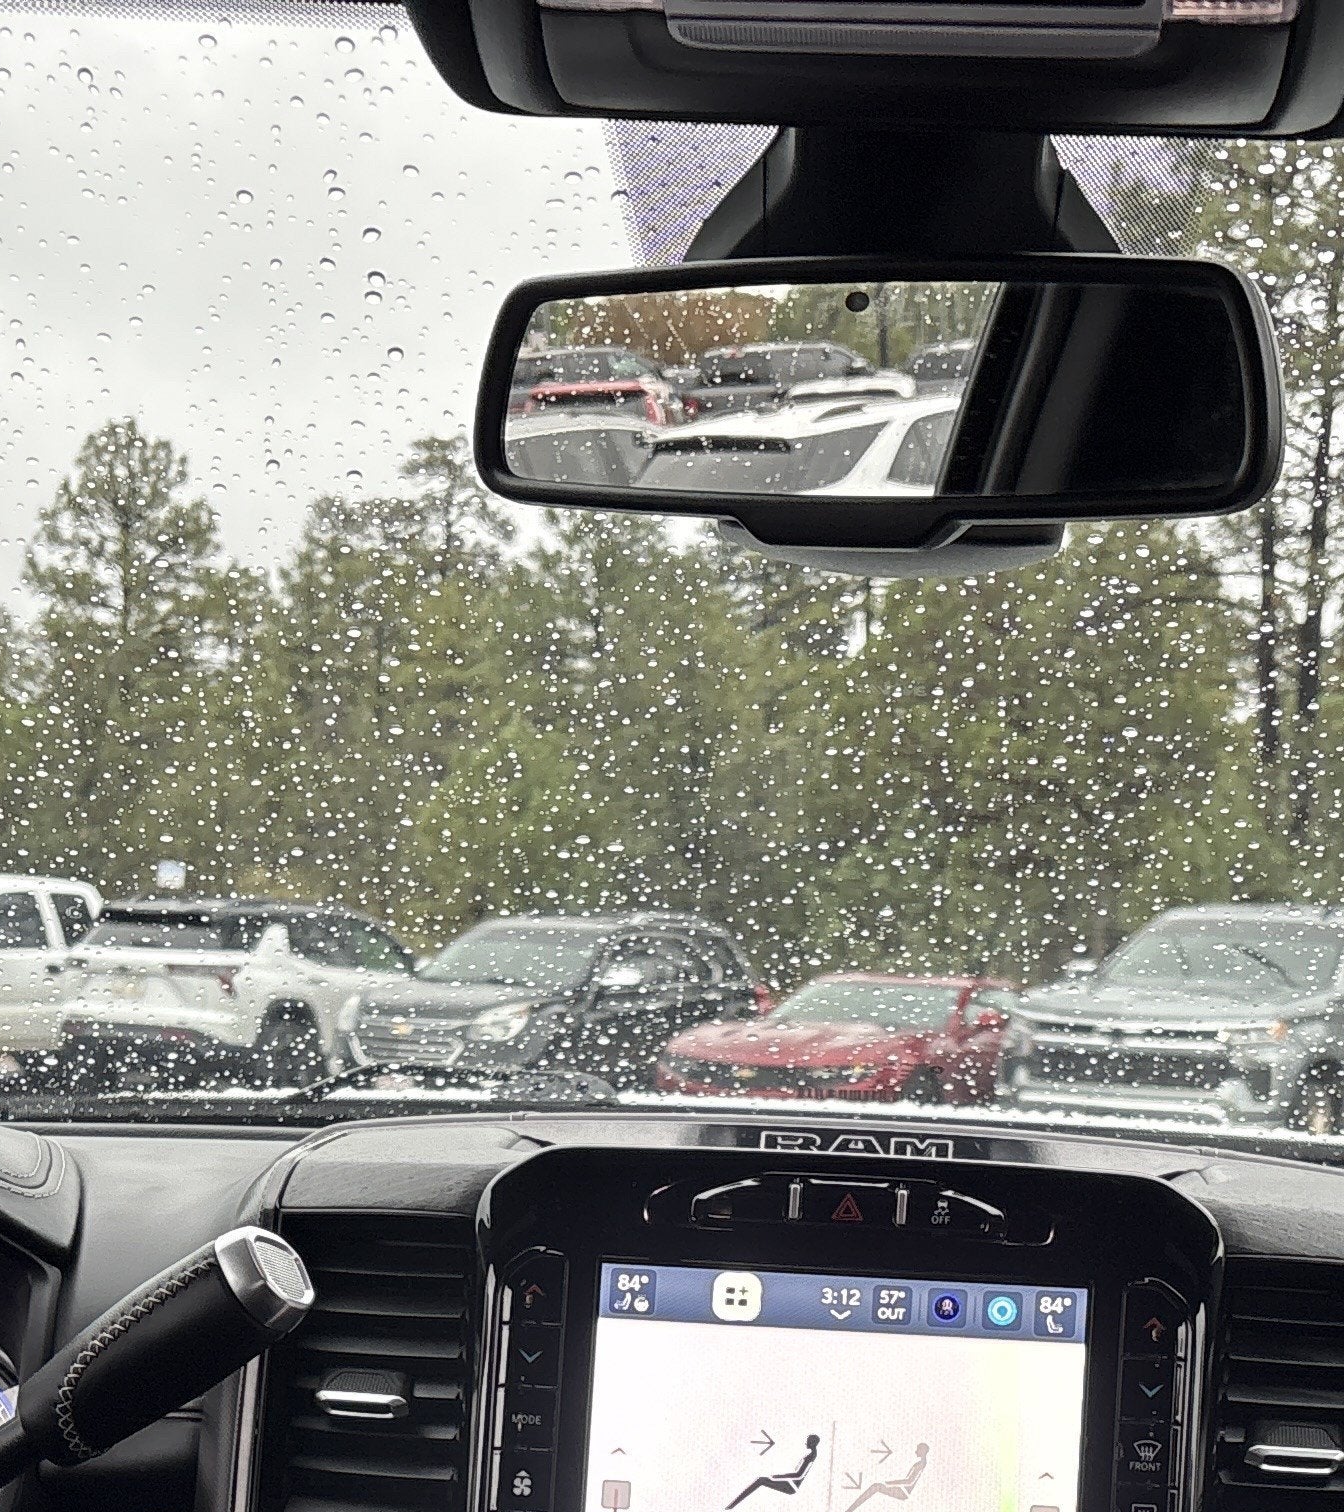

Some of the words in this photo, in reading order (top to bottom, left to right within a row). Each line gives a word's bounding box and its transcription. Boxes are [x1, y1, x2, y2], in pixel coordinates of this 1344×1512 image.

[760, 1131, 954, 1160] RAM
[931, 1215, 951, 1225] OFF
[821, 1286, 862, 1308] 3:12
[877, 1304, 907, 1322] OUT
[511, 1413, 542, 1426] MODE
[1129, 1462, 1162, 1472] FRONT
